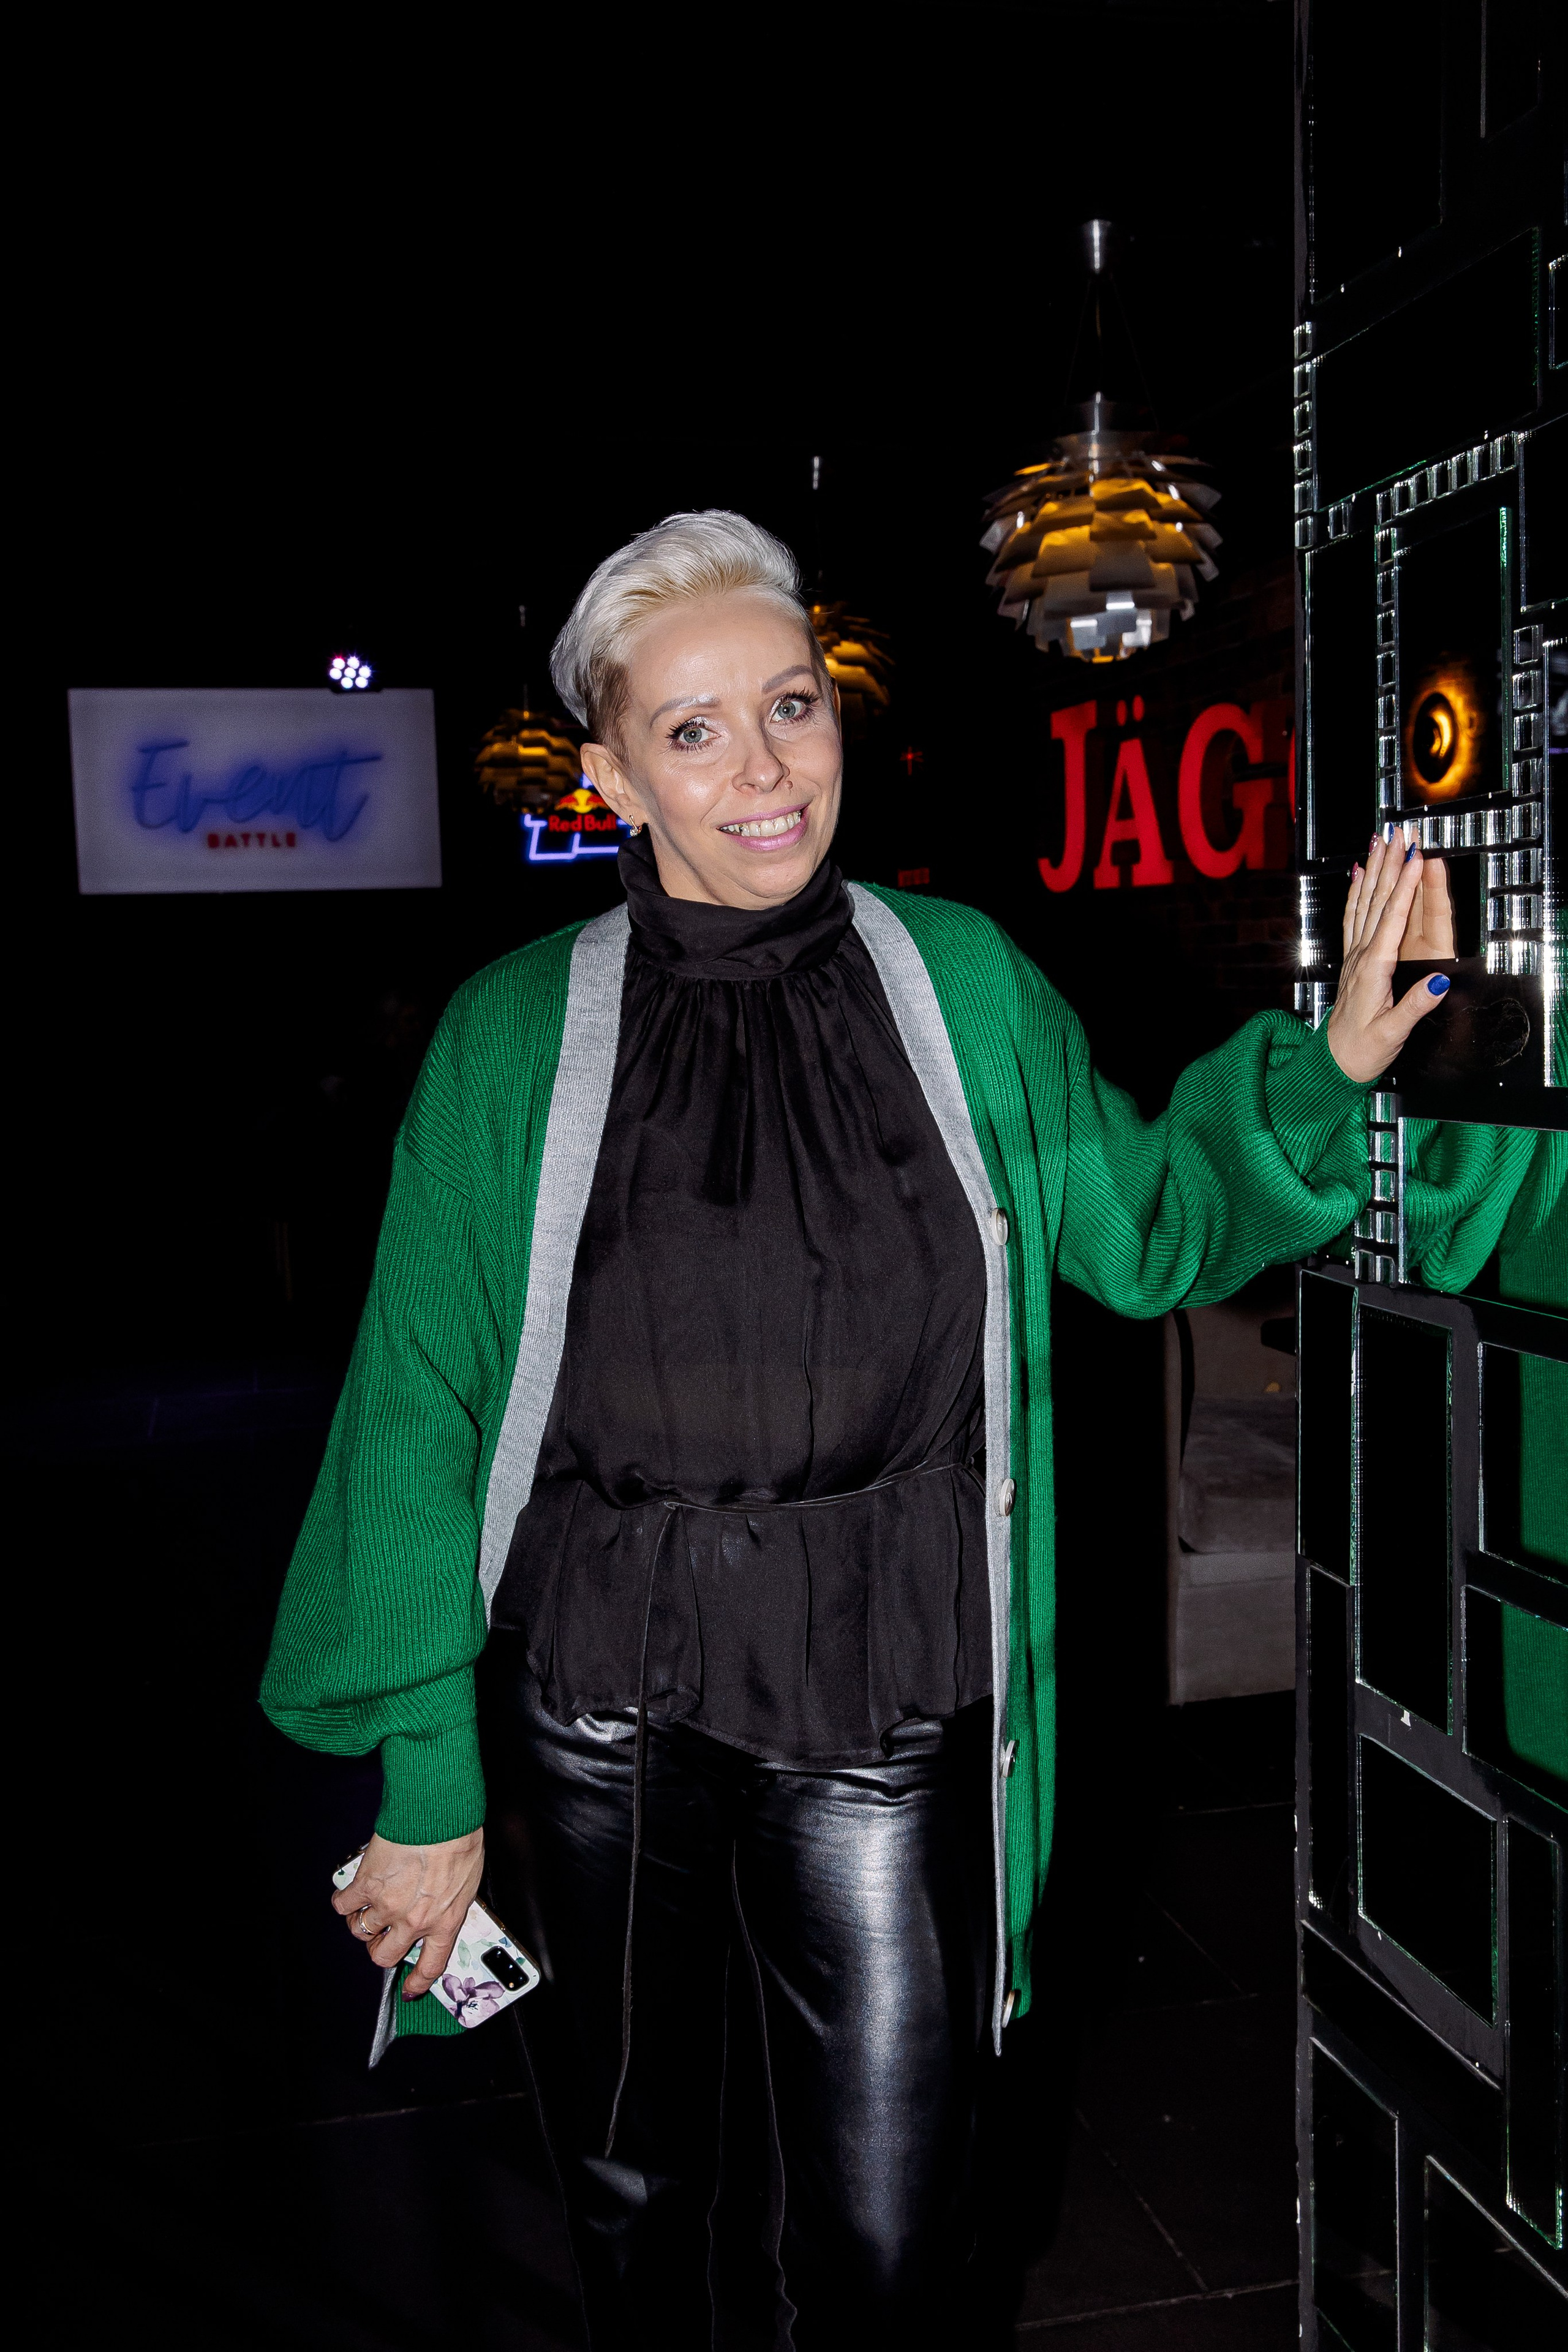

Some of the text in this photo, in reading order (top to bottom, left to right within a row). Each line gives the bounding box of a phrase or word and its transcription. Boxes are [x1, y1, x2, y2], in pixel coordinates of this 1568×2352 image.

[131, 739, 383, 843] Event
[1038, 695, 1295, 892] JÄG
[207, 832, 296, 849] BATTLE
[548, 813, 616, 832] Red Bull
